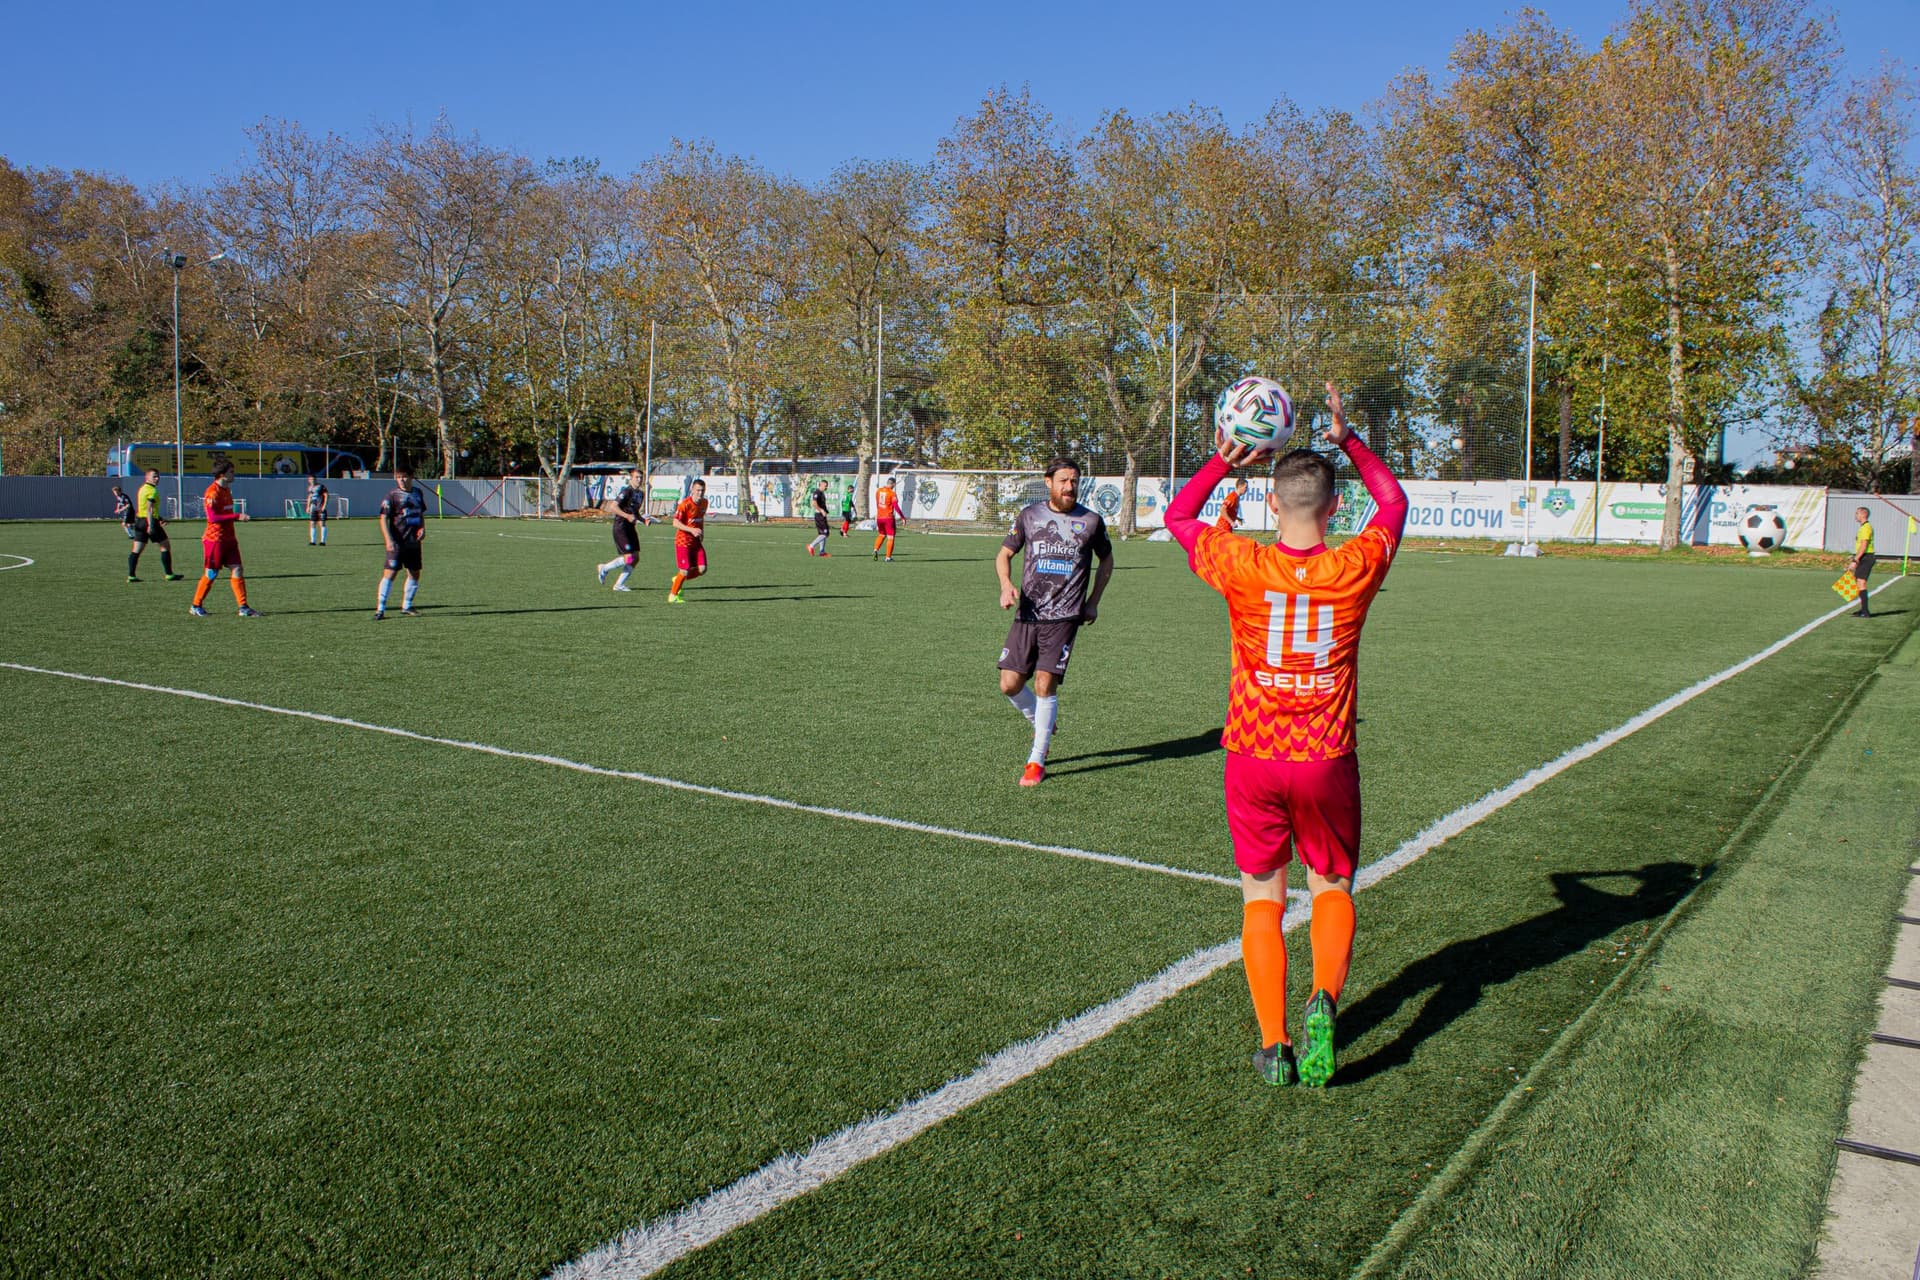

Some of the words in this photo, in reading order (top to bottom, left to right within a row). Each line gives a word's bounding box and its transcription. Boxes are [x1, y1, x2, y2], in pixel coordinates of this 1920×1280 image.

[1409, 507, 1444, 526] 020
[1450, 508, 1503, 528] СОЧИ
[1038, 559, 1073, 573] Vitamin
[1264, 590, 1338, 668] 14
[1255, 670, 1336, 689] SEUS
